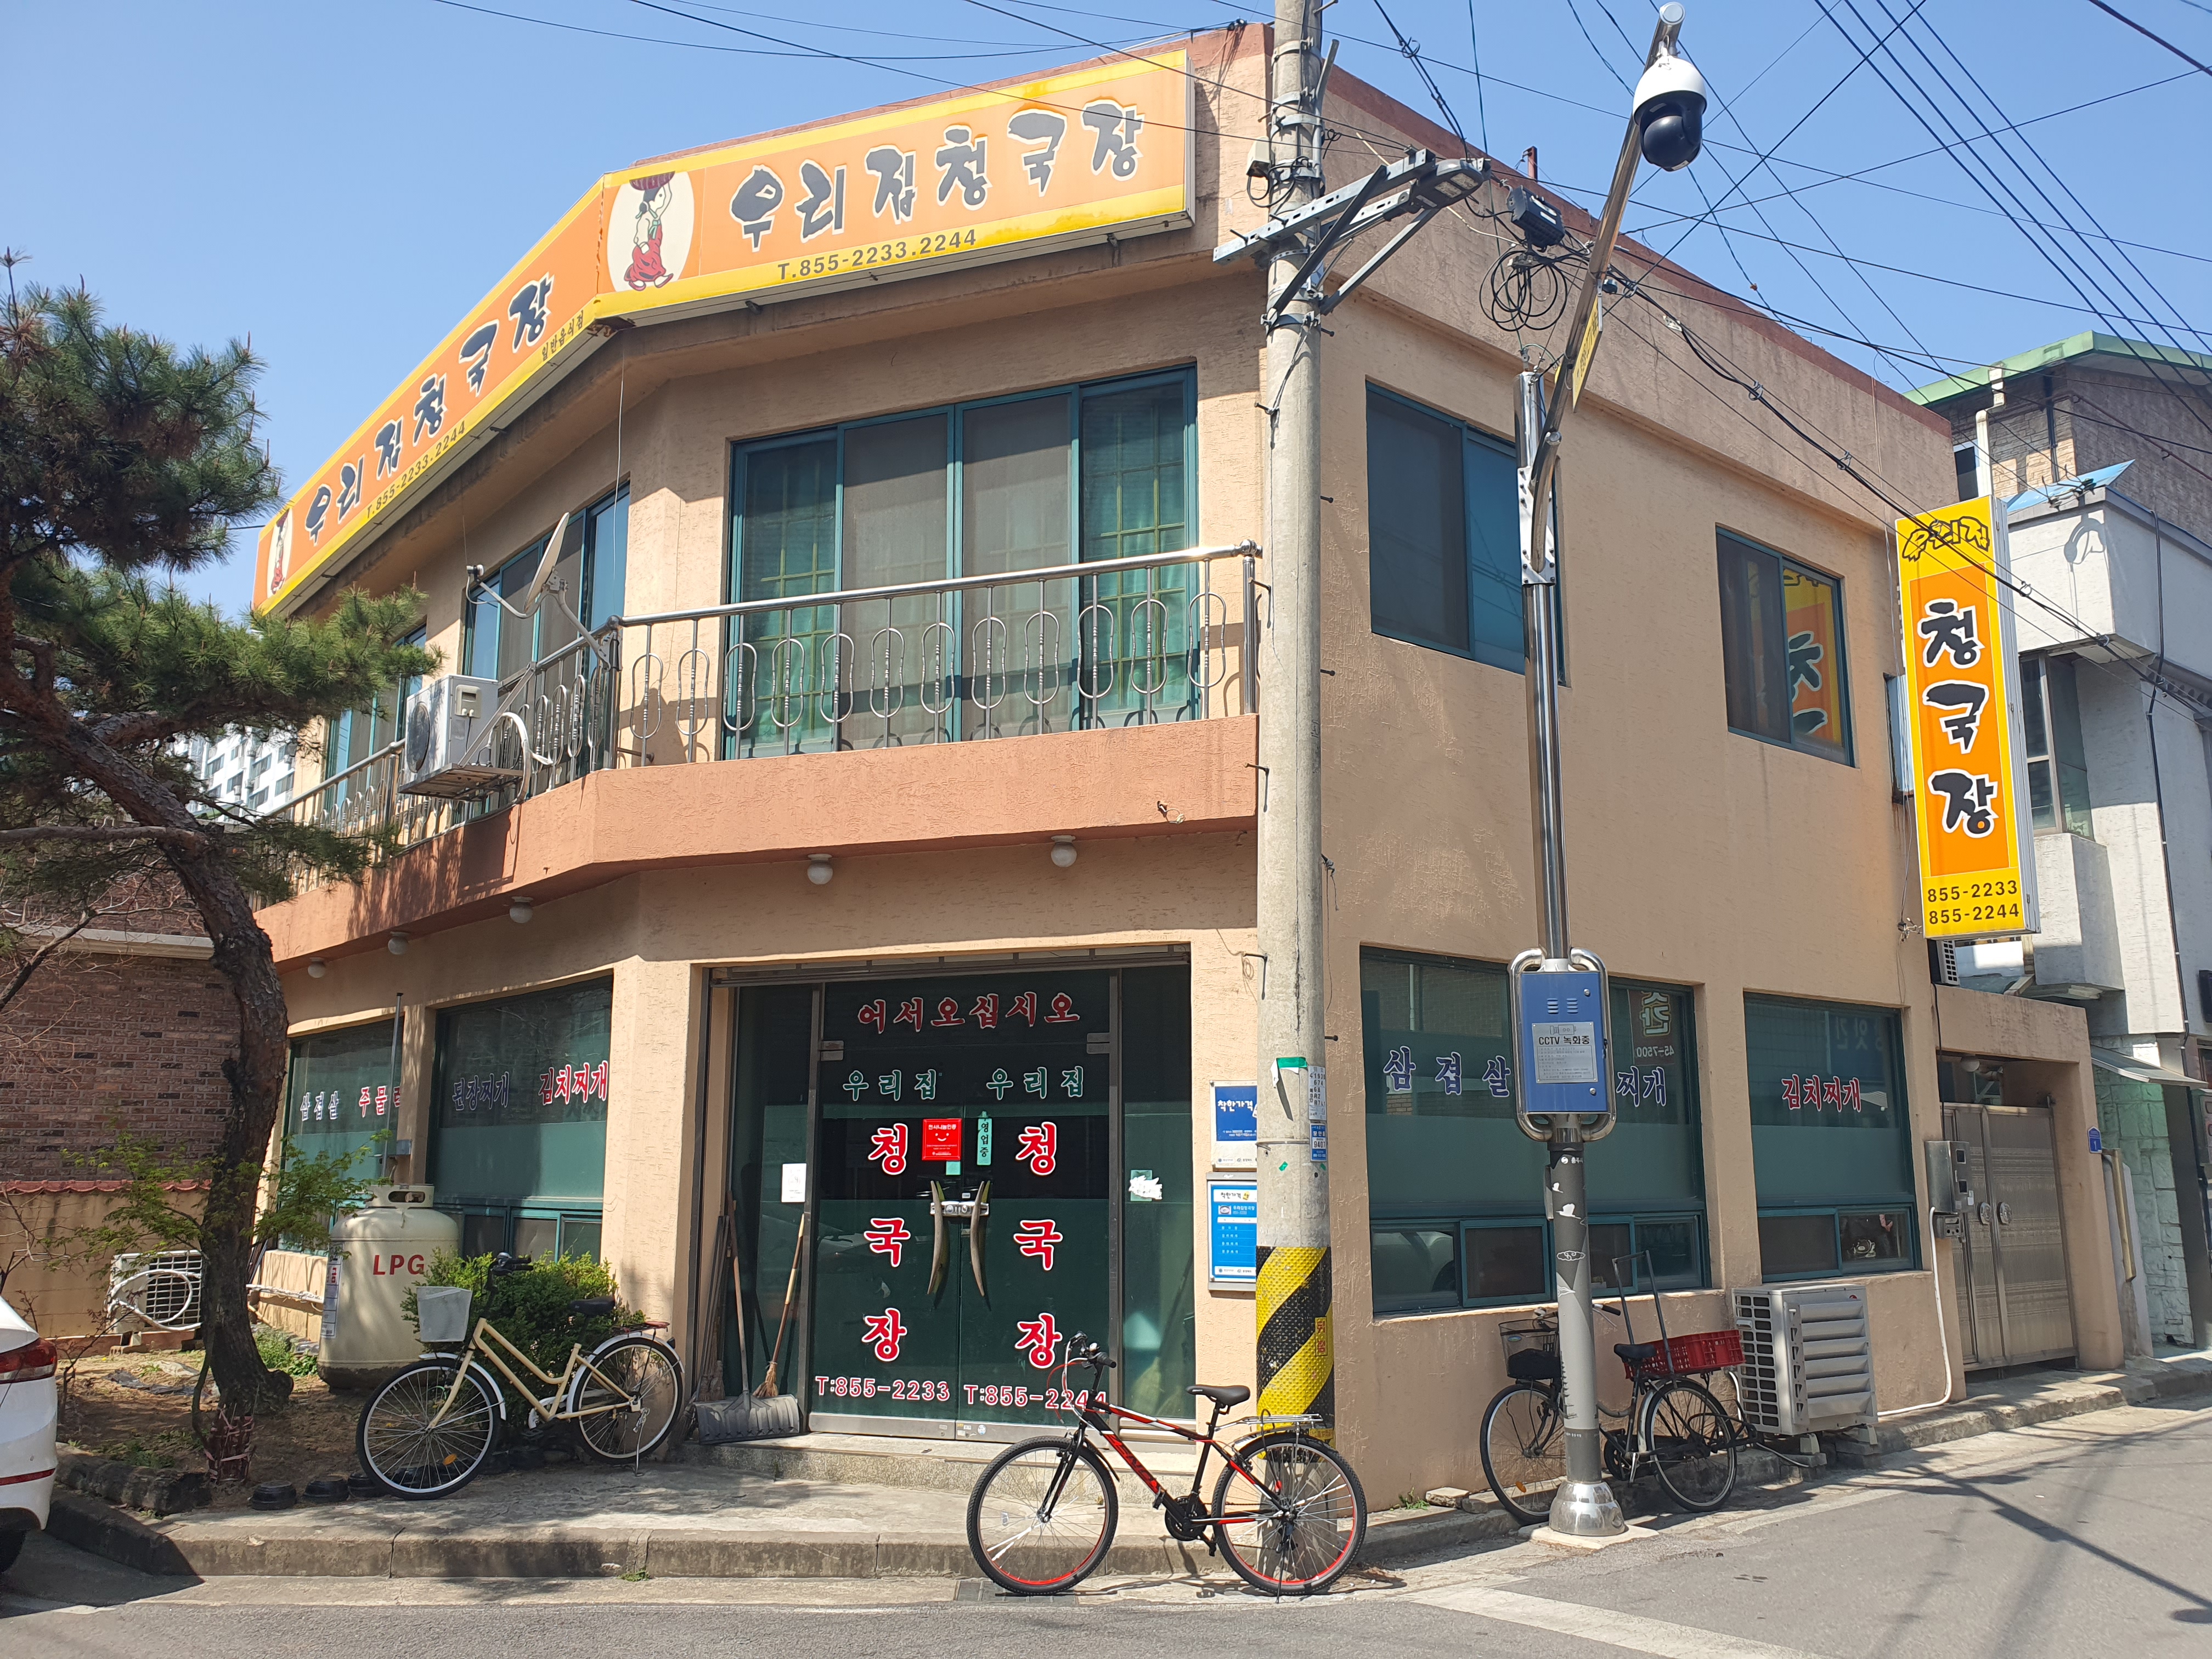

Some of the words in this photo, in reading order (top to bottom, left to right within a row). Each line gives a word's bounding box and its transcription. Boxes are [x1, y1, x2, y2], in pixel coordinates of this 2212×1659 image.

[777, 229, 977, 280] T.855-2233.2244
[541, 309, 584, 362] 일반음식점
[366, 421, 465, 519] T.855-2233.2244
[1917, 598, 1998, 838] 청국장
[1927, 880, 2018, 904] 855-2233
[1929, 904, 2020, 926] 855-2244
[857, 991, 1080, 1034] 어서오십시오
[1538, 1036, 1560, 1045] CCTV
[1563, 1035, 1590, 1045] 녹화중
[452, 1071, 510, 1111] 된장찌개
[538, 1060, 608, 1105] 김치찌개
[842, 1069, 937, 1101] 우리집
[986, 1065, 1085, 1101] 우리집
[1383, 1046, 1511, 1097] 삼겹살
[300, 1090, 339, 1121] 삼겹살
[1217, 1099, 1253, 1112] 착한가격
[1781, 1074, 1861, 1112] 김치찌개
[980, 1121, 989, 1158] 영업중
[861, 1122, 911, 1363] 청국장
[1013, 1121, 1064, 1369] 청국장
[373, 1254, 425, 1276] LPG
[815, 1375, 951, 1402] T:855-2233
